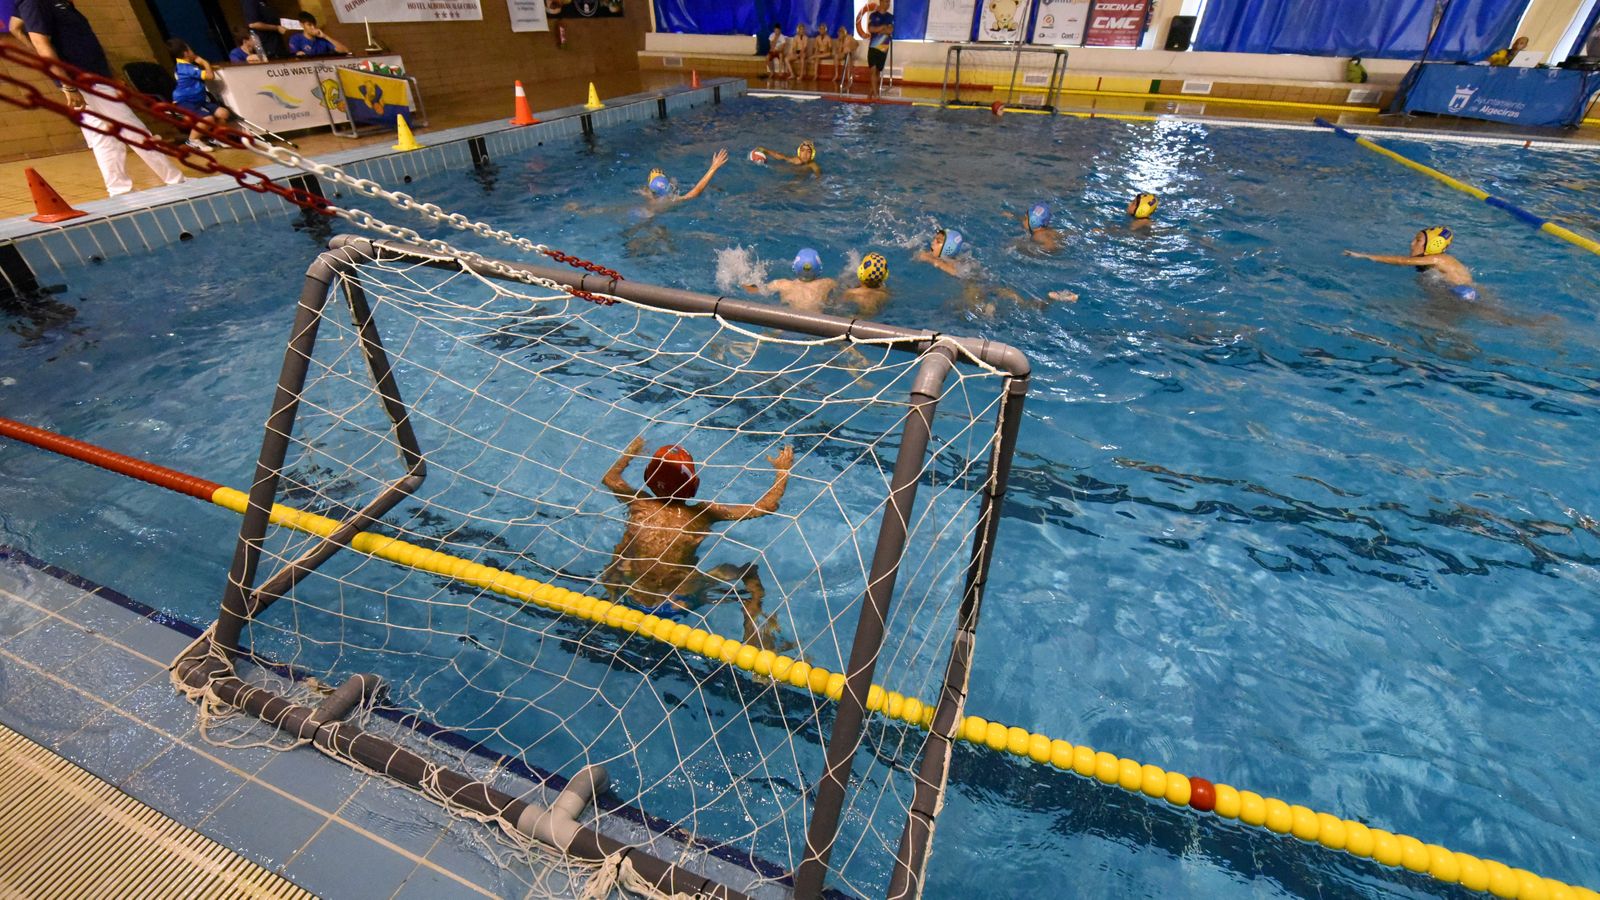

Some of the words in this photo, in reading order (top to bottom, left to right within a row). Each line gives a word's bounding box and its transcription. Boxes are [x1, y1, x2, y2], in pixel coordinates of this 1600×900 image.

[1095, 3, 1144, 11] COCINAS
[1092, 16, 1140, 29] CMC
[267, 67, 290, 78] CLUB
[269, 111, 310, 122] Emalgesa
[1479, 105, 1520, 118] Algeciras
